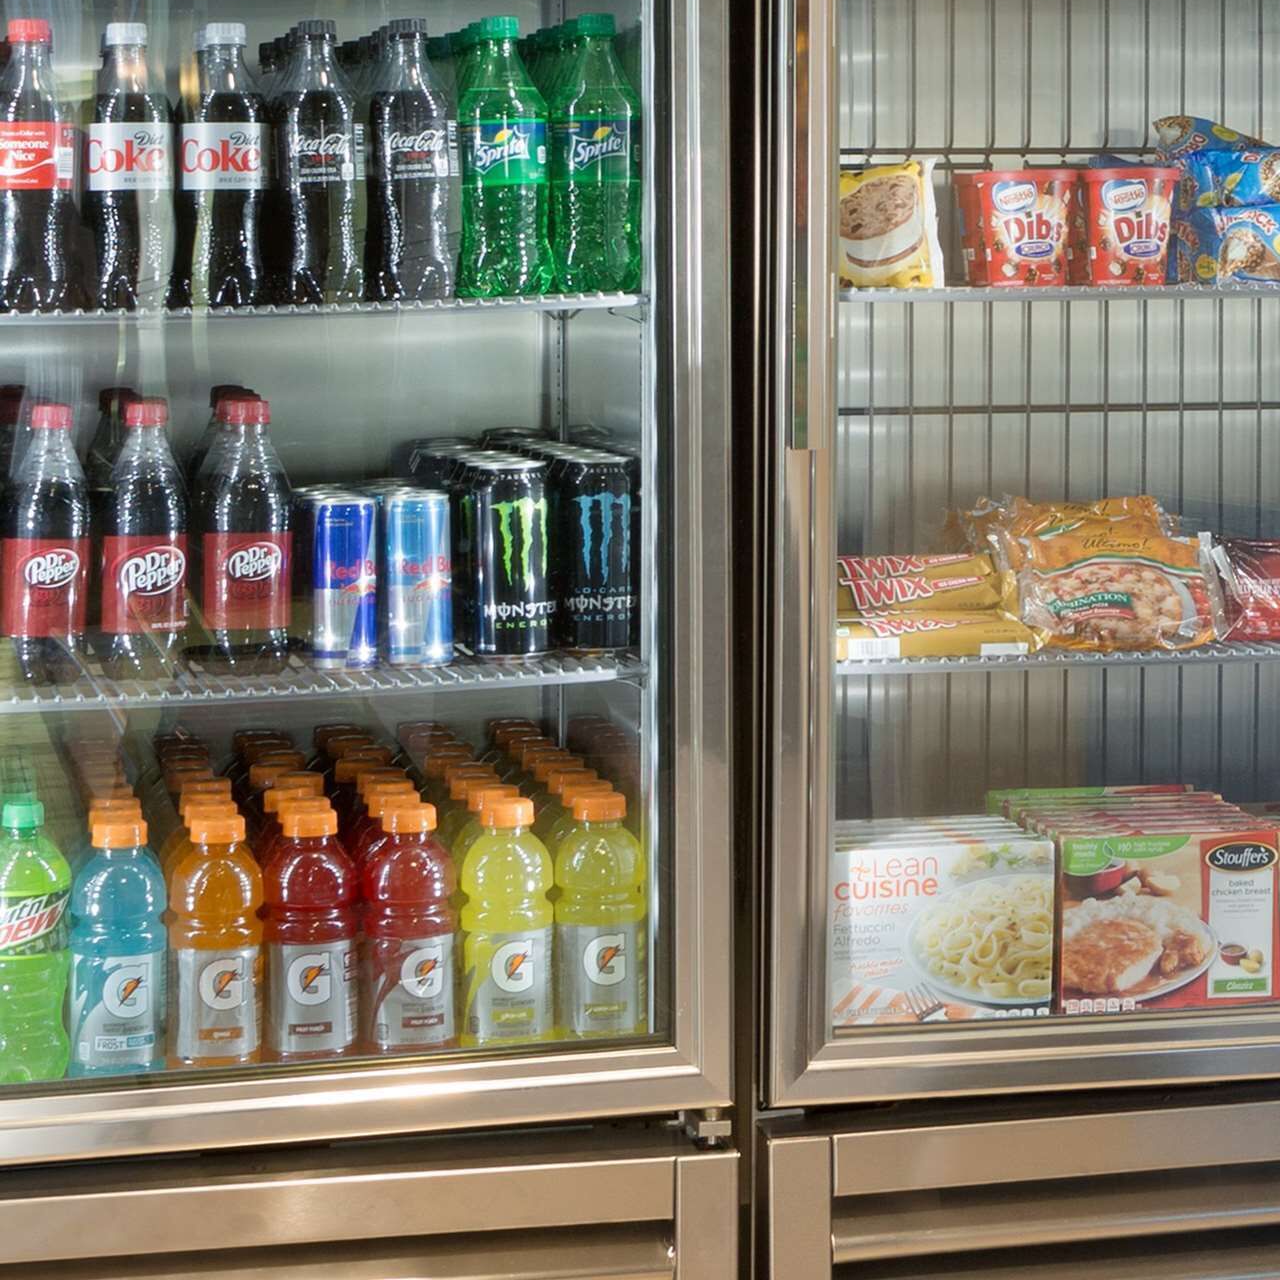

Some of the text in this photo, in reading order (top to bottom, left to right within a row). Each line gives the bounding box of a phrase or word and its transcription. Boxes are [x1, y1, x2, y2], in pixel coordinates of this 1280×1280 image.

[134, 131, 165, 146] Diet
[230, 131, 261, 146] Diet
[388, 129, 446, 154] Coca-Cola
[574, 135, 622, 163] Sprite
[11, 150, 35, 162] Nice
[86, 138, 165, 173] Coke
[182, 138, 261, 173] Coke
[476, 137, 526, 168] Sprite
[1004, 211, 1064, 245] Dibs
[1114, 210, 1168, 245] Dibs
[45, 550, 65, 569] Dr
[144, 551, 170, 571] Dr
[230, 553, 280, 578] Pepper
[249, 546, 268, 563] Dr
[401, 555, 434, 577] Red
[837, 554, 925, 581] TWIX
[29, 557, 77, 585] Pepper
[123, 556, 183, 593] Pepper
[328, 559, 365, 580] Red
[839, 576, 935, 610] TWIX
[874, 856, 939, 878] Lean
[1214, 847, 1269, 868] Stouffer's
[834, 877, 939, 901] cuisine
[1212, 887, 1271, 896] chicken breast
[1228, 879, 1255, 888] baked
[833, 935, 881, 947] Alfredo
[401, 944, 444, 999] G
[491, 939, 535, 993] G
[584, 933, 627, 987] G
[102, 962, 150, 1019] G
[199, 956, 246, 1011] G
[287, 952, 332, 1006] G
